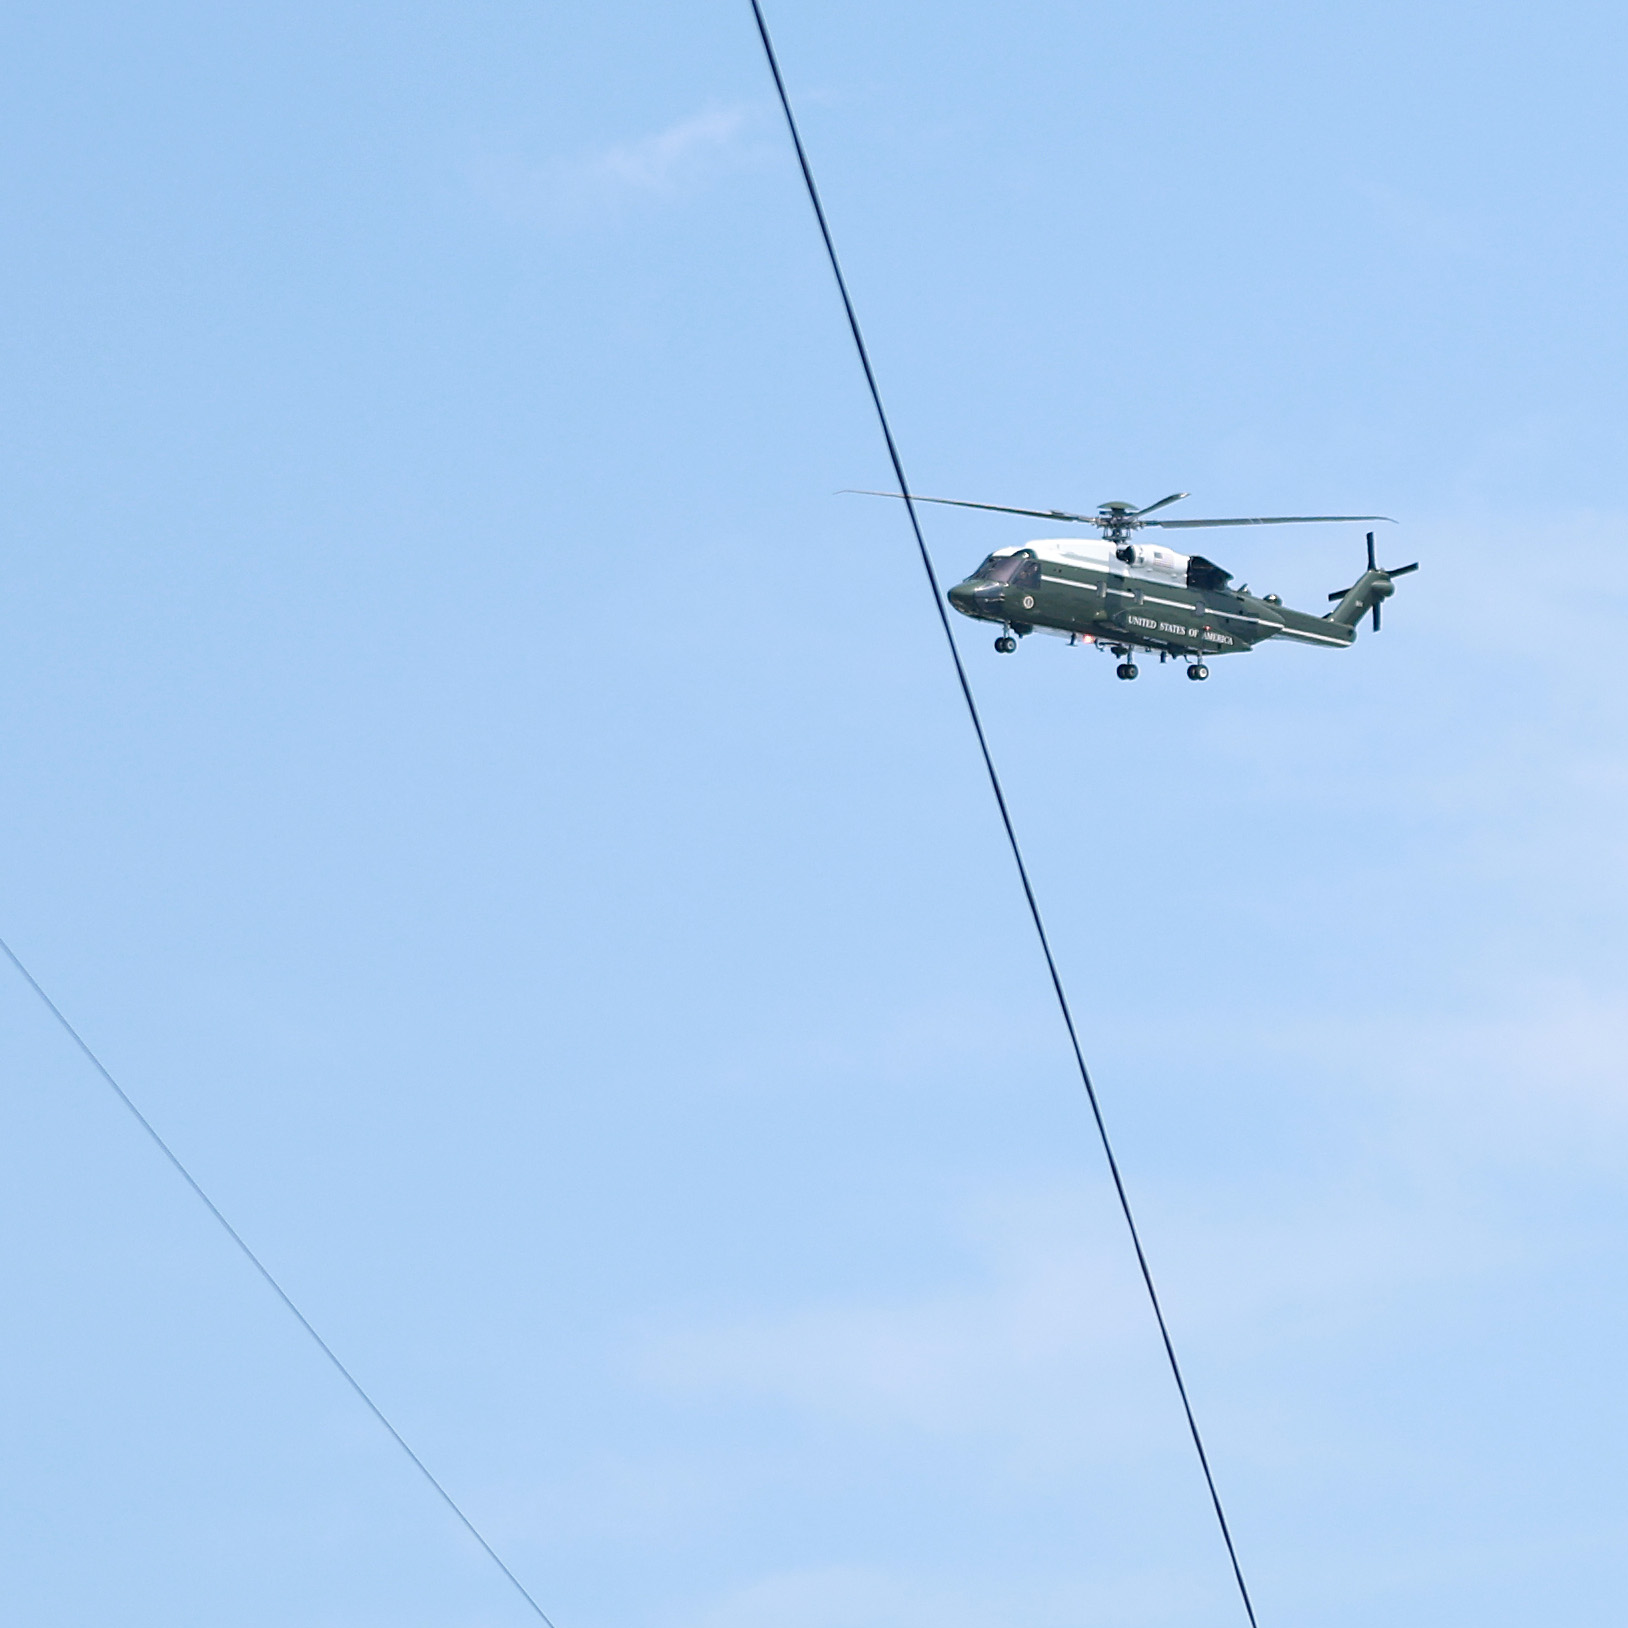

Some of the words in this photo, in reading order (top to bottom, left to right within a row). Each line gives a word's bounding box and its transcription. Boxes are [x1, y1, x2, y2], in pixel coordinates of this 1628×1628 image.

[1128, 615, 1157, 630] UNITED
[1160, 622, 1186, 636] STATES
[1188, 628, 1199, 638] OF
[1202, 631, 1234, 646] AMERICA
